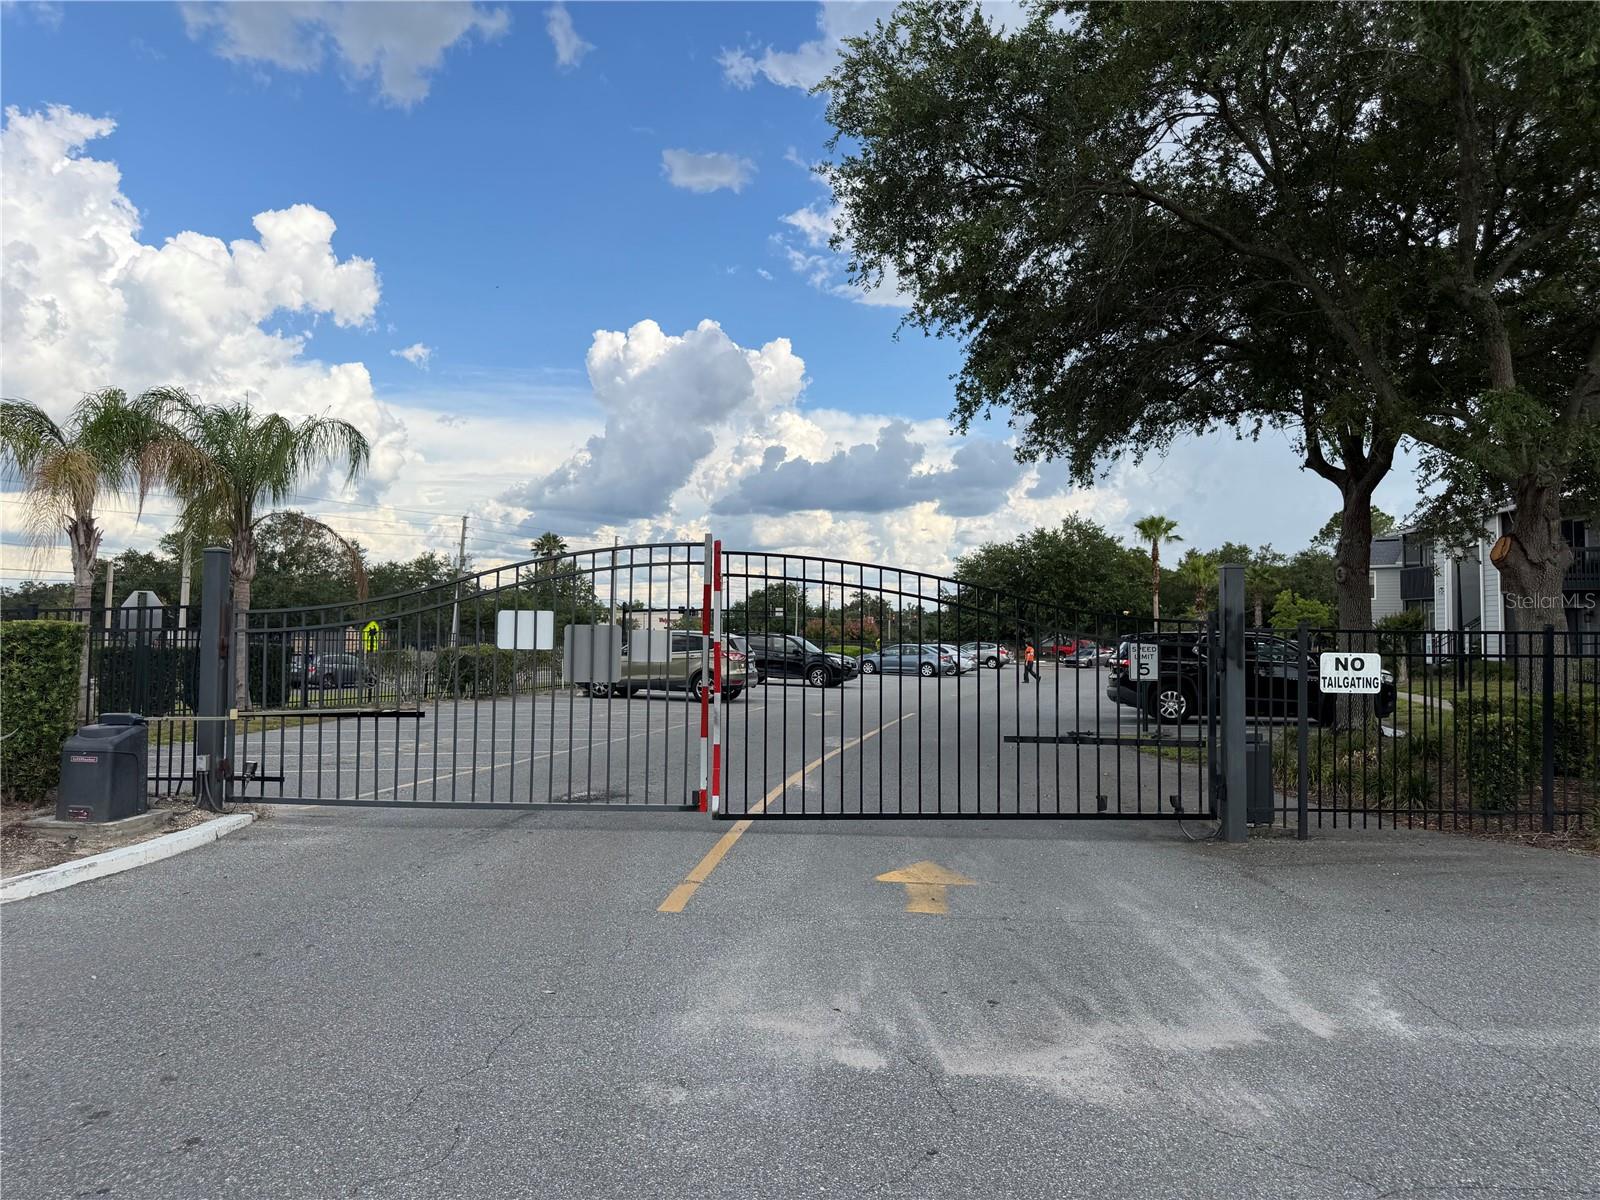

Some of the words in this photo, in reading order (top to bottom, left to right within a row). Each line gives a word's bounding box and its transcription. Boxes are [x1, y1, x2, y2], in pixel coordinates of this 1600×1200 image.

[1139, 663, 1150, 676] 5
[1334, 657, 1365, 671] NO
[1321, 676, 1379, 688] TAILGATING
